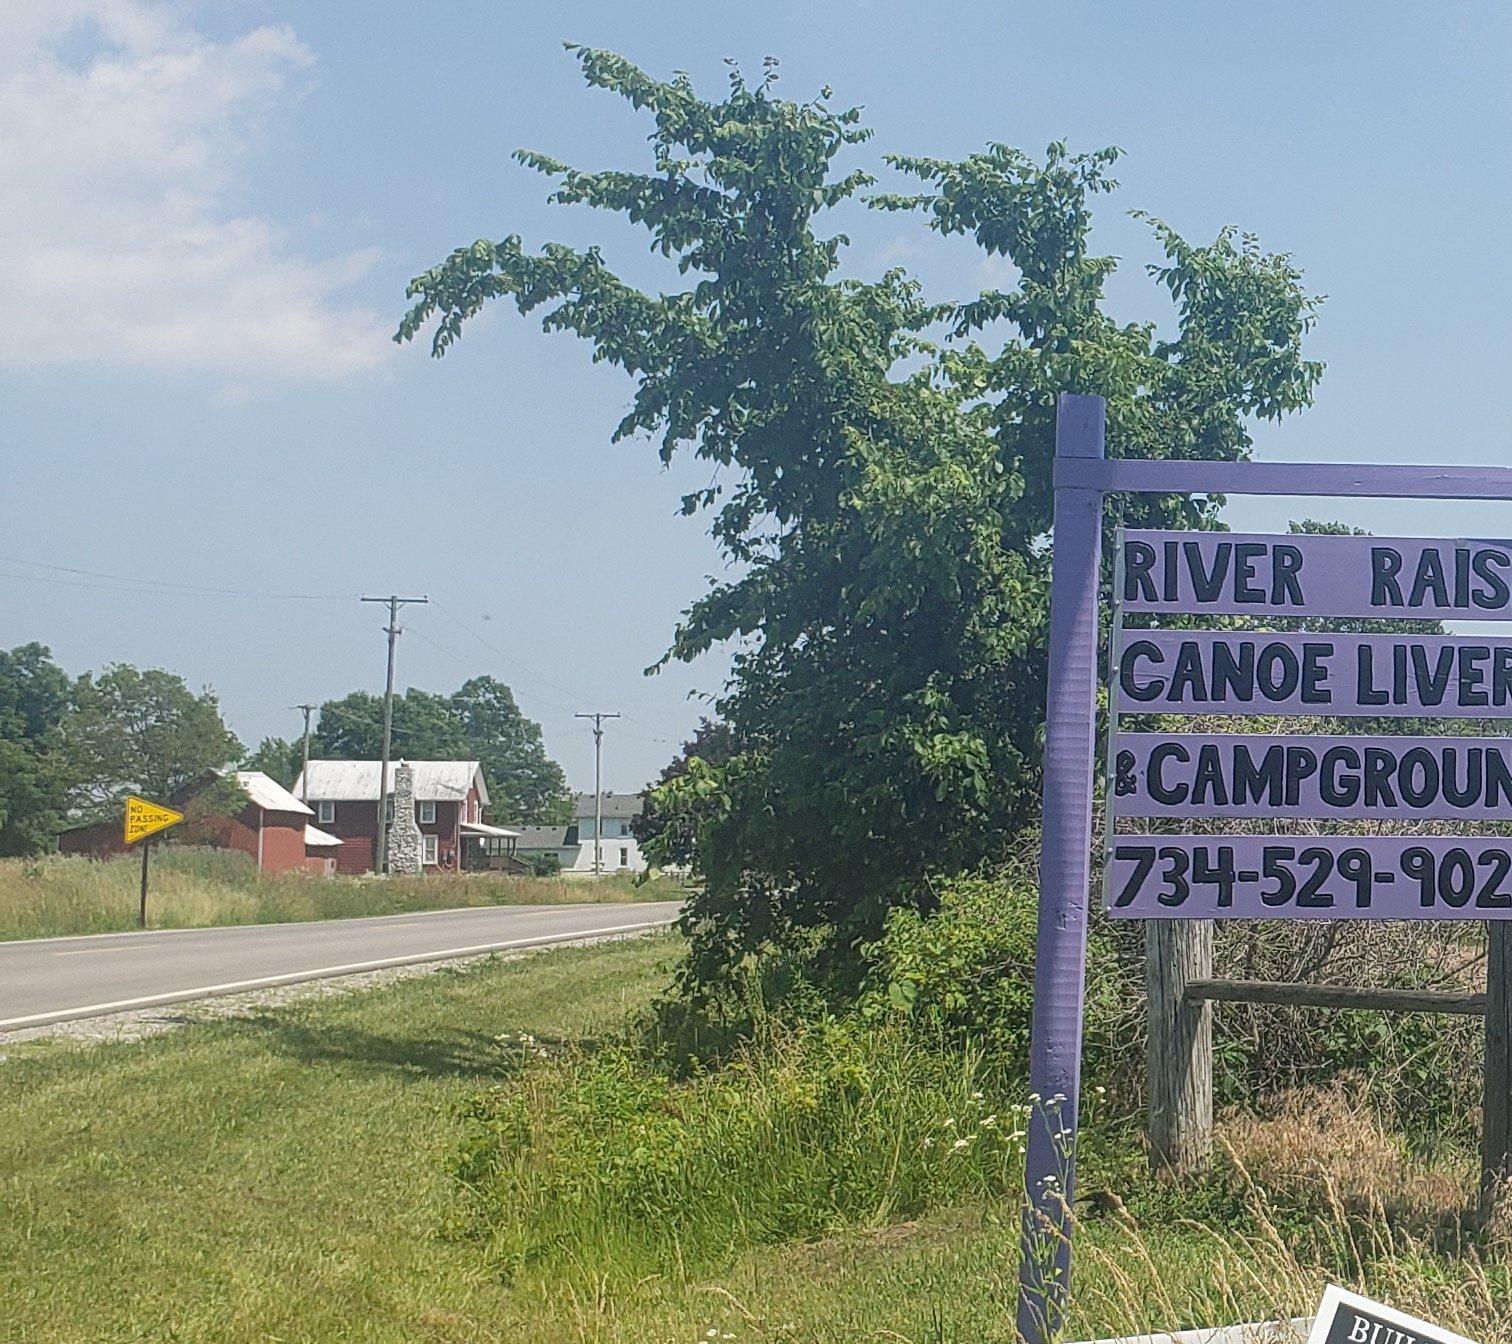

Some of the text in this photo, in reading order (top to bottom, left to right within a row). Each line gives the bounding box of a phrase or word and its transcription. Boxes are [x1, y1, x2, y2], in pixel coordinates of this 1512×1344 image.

[1123, 541, 1305, 606] RIVER
[1119, 640, 1335, 704] CANOE
[130, 805, 143, 814] NO
[130, 813, 169, 823] PASSING
[129, 824, 148, 834] ZONE
